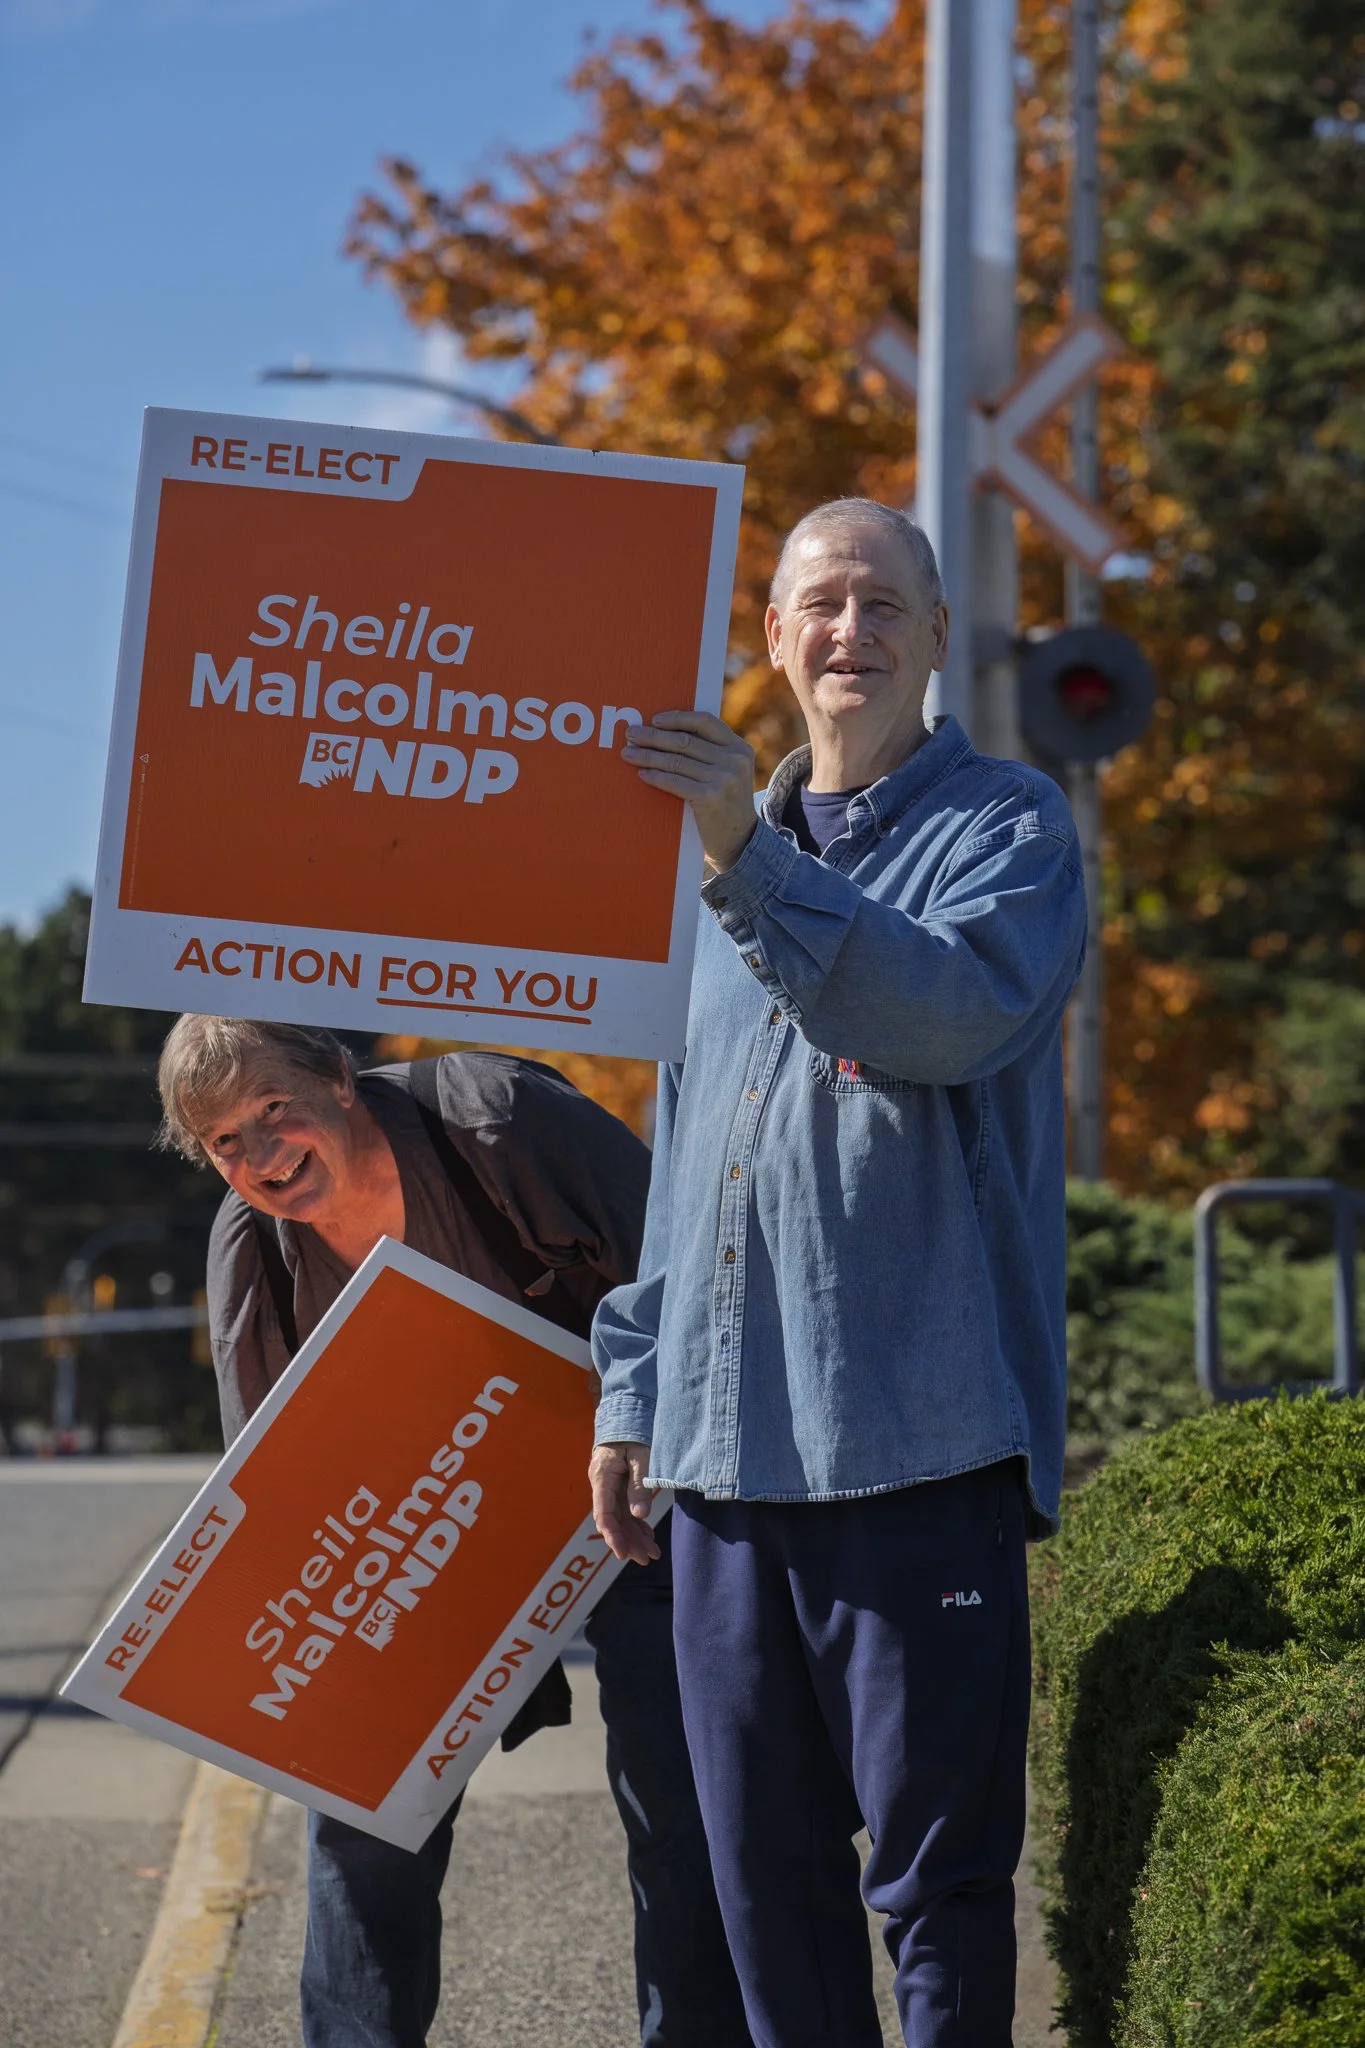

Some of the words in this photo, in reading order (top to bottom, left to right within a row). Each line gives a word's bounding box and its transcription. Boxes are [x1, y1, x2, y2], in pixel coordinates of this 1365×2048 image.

[190, 436, 400, 486] RE-ELECT
[248, 594, 474, 665] Sheila
[189, 652, 643, 749] Malcolmson
[310, 739, 353, 765] BC
[353, 737, 519, 804] NDP
[174, 938, 361, 989] ACTION
[378, 957, 476, 1000] FOR
[495, 967, 598, 1012] YOU
[105, 1505, 228, 1671] RE-ELECT
[245, 1485, 381, 1661] Sheila
[249, 1375, 520, 1720] Malcolmson
[361, 1602, 391, 1638] BC
[383, 1480, 483, 1612] NDP
[942, 1590, 982, 1607] FILA
[427, 1640, 533, 1780] ACTION
[527, 1554, 595, 1631] FOR
